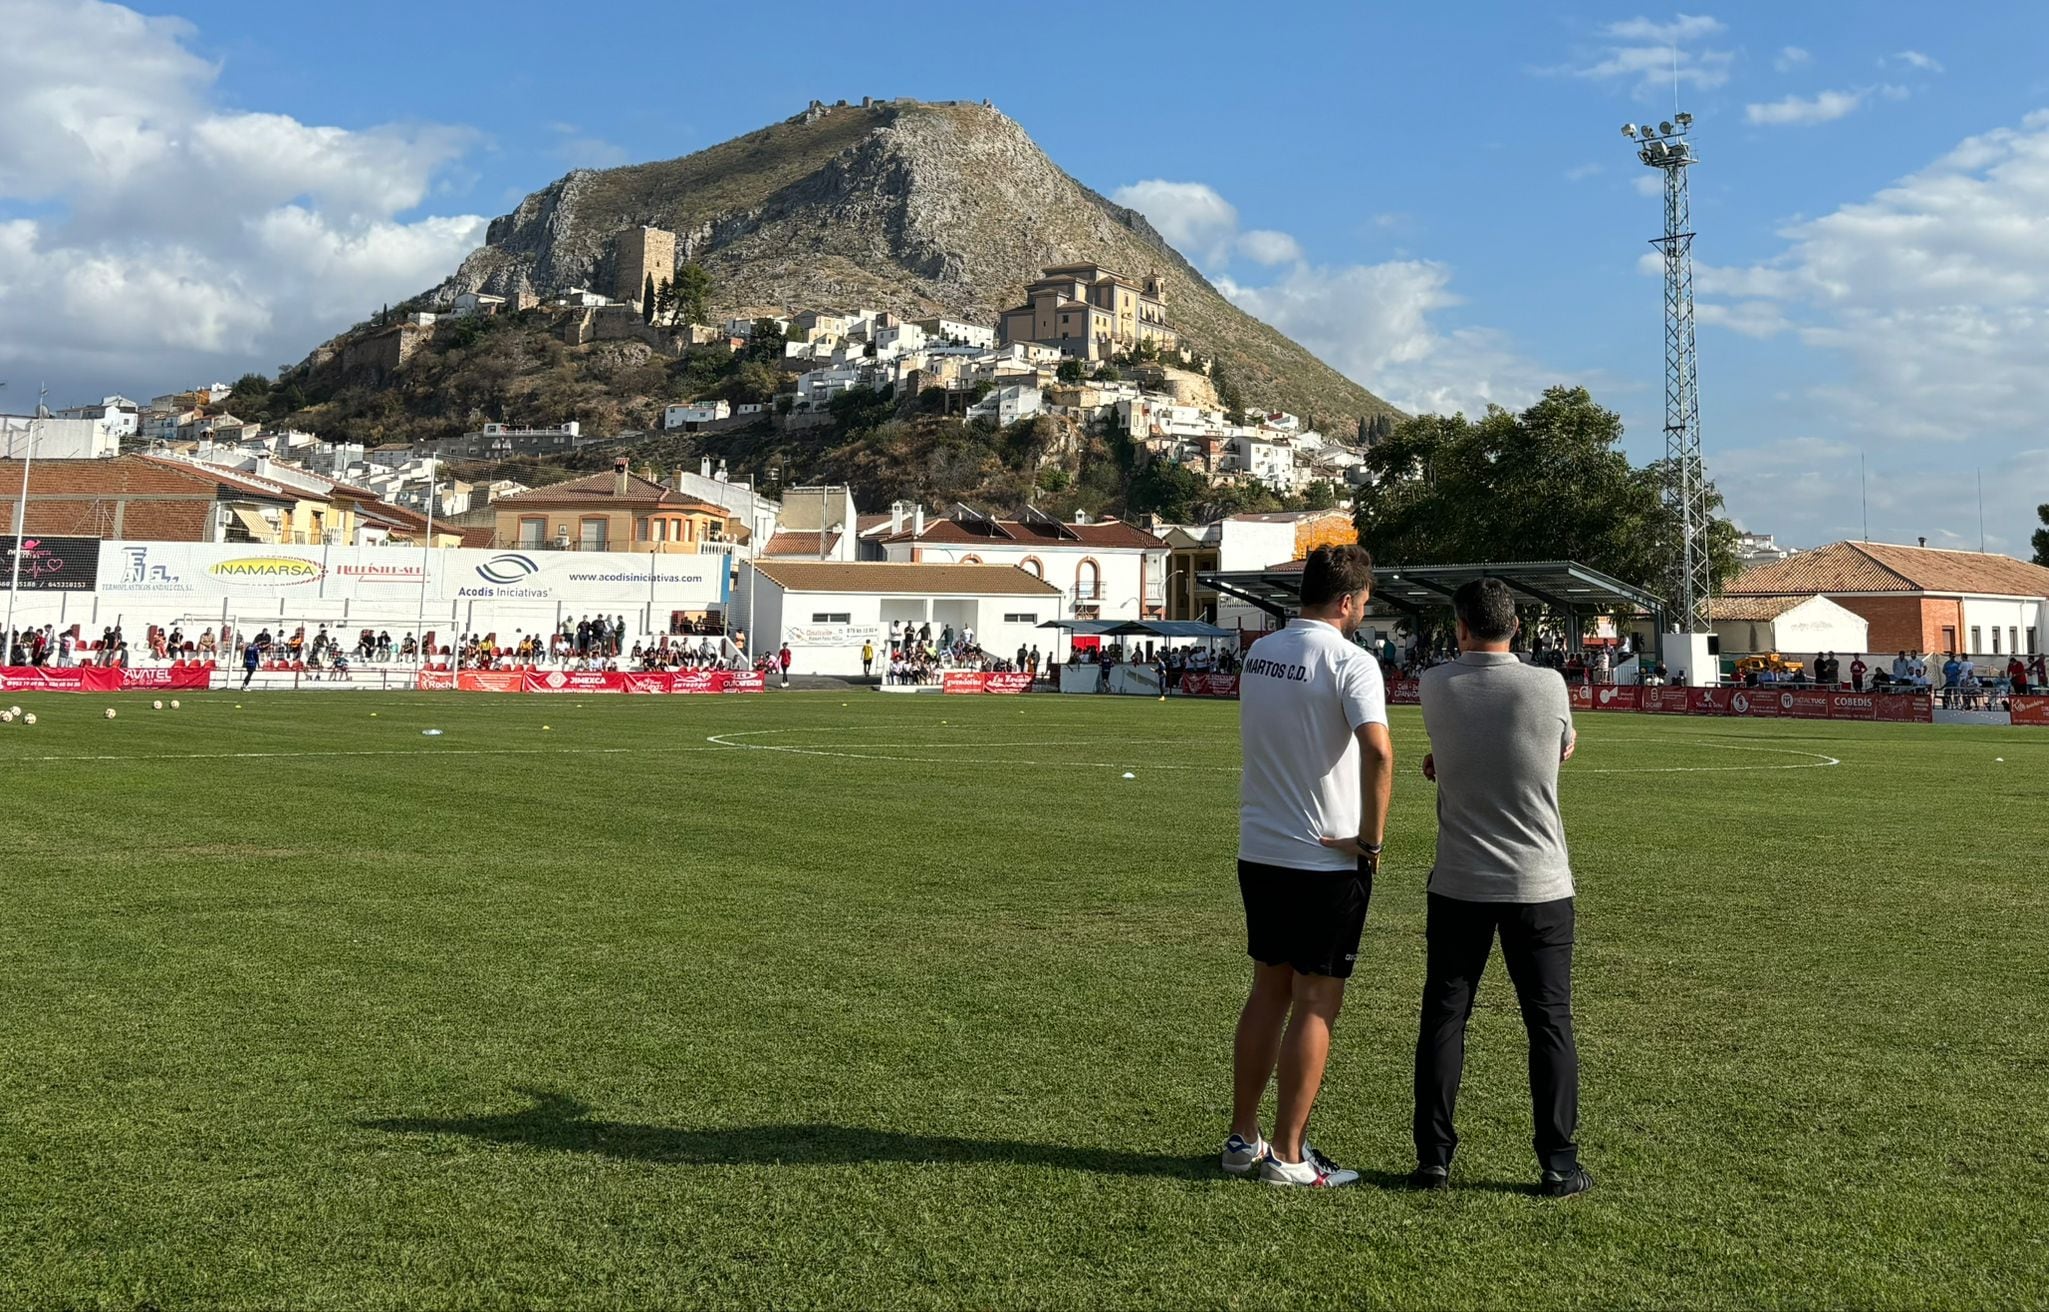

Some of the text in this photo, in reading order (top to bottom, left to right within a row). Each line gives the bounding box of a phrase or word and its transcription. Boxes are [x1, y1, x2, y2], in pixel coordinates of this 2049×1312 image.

[215, 563, 314, 576] INAMARSA
[569, 572, 703, 583] www.acodisiniciativas.com
[458, 586, 549, 598] Acodis Iniciativas
[124, 669, 172, 679] AVATEL
[1244, 658, 1308, 683] MARTOS C.D.
[569, 676, 607, 685] JIMEXCA
